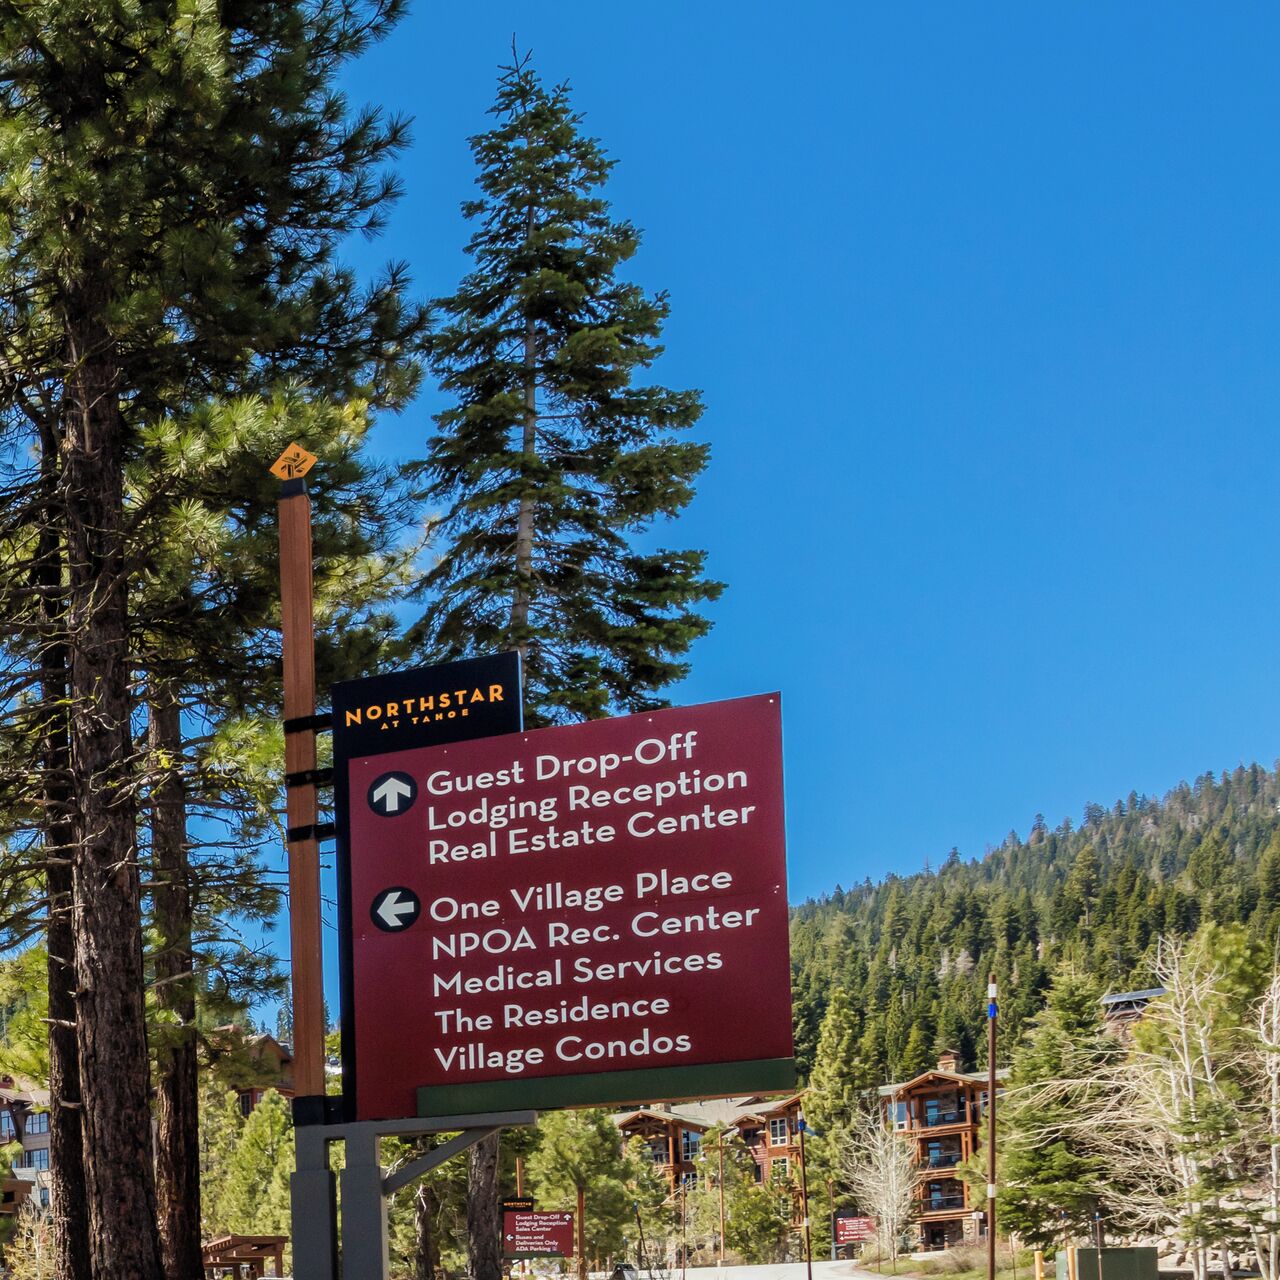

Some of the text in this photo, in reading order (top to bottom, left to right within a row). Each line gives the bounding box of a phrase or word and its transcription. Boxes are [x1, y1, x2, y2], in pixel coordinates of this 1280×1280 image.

[345, 684, 504, 727] NORTHSTAR
[381, 708, 469, 730] AT TAHOE
[427, 731, 700, 795] Guest Drop-Off
[429, 770, 747, 830] Lodging Reception
[430, 805, 756, 864] Real Estate Center
[430, 869, 732, 921] One Village Place
[433, 906, 760, 960] NPOA Rec. Center
[434, 951, 722, 997] Medical Services
[435, 996, 669, 1033] The Residence
[434, 1028, 691, 1073] Village Condos
